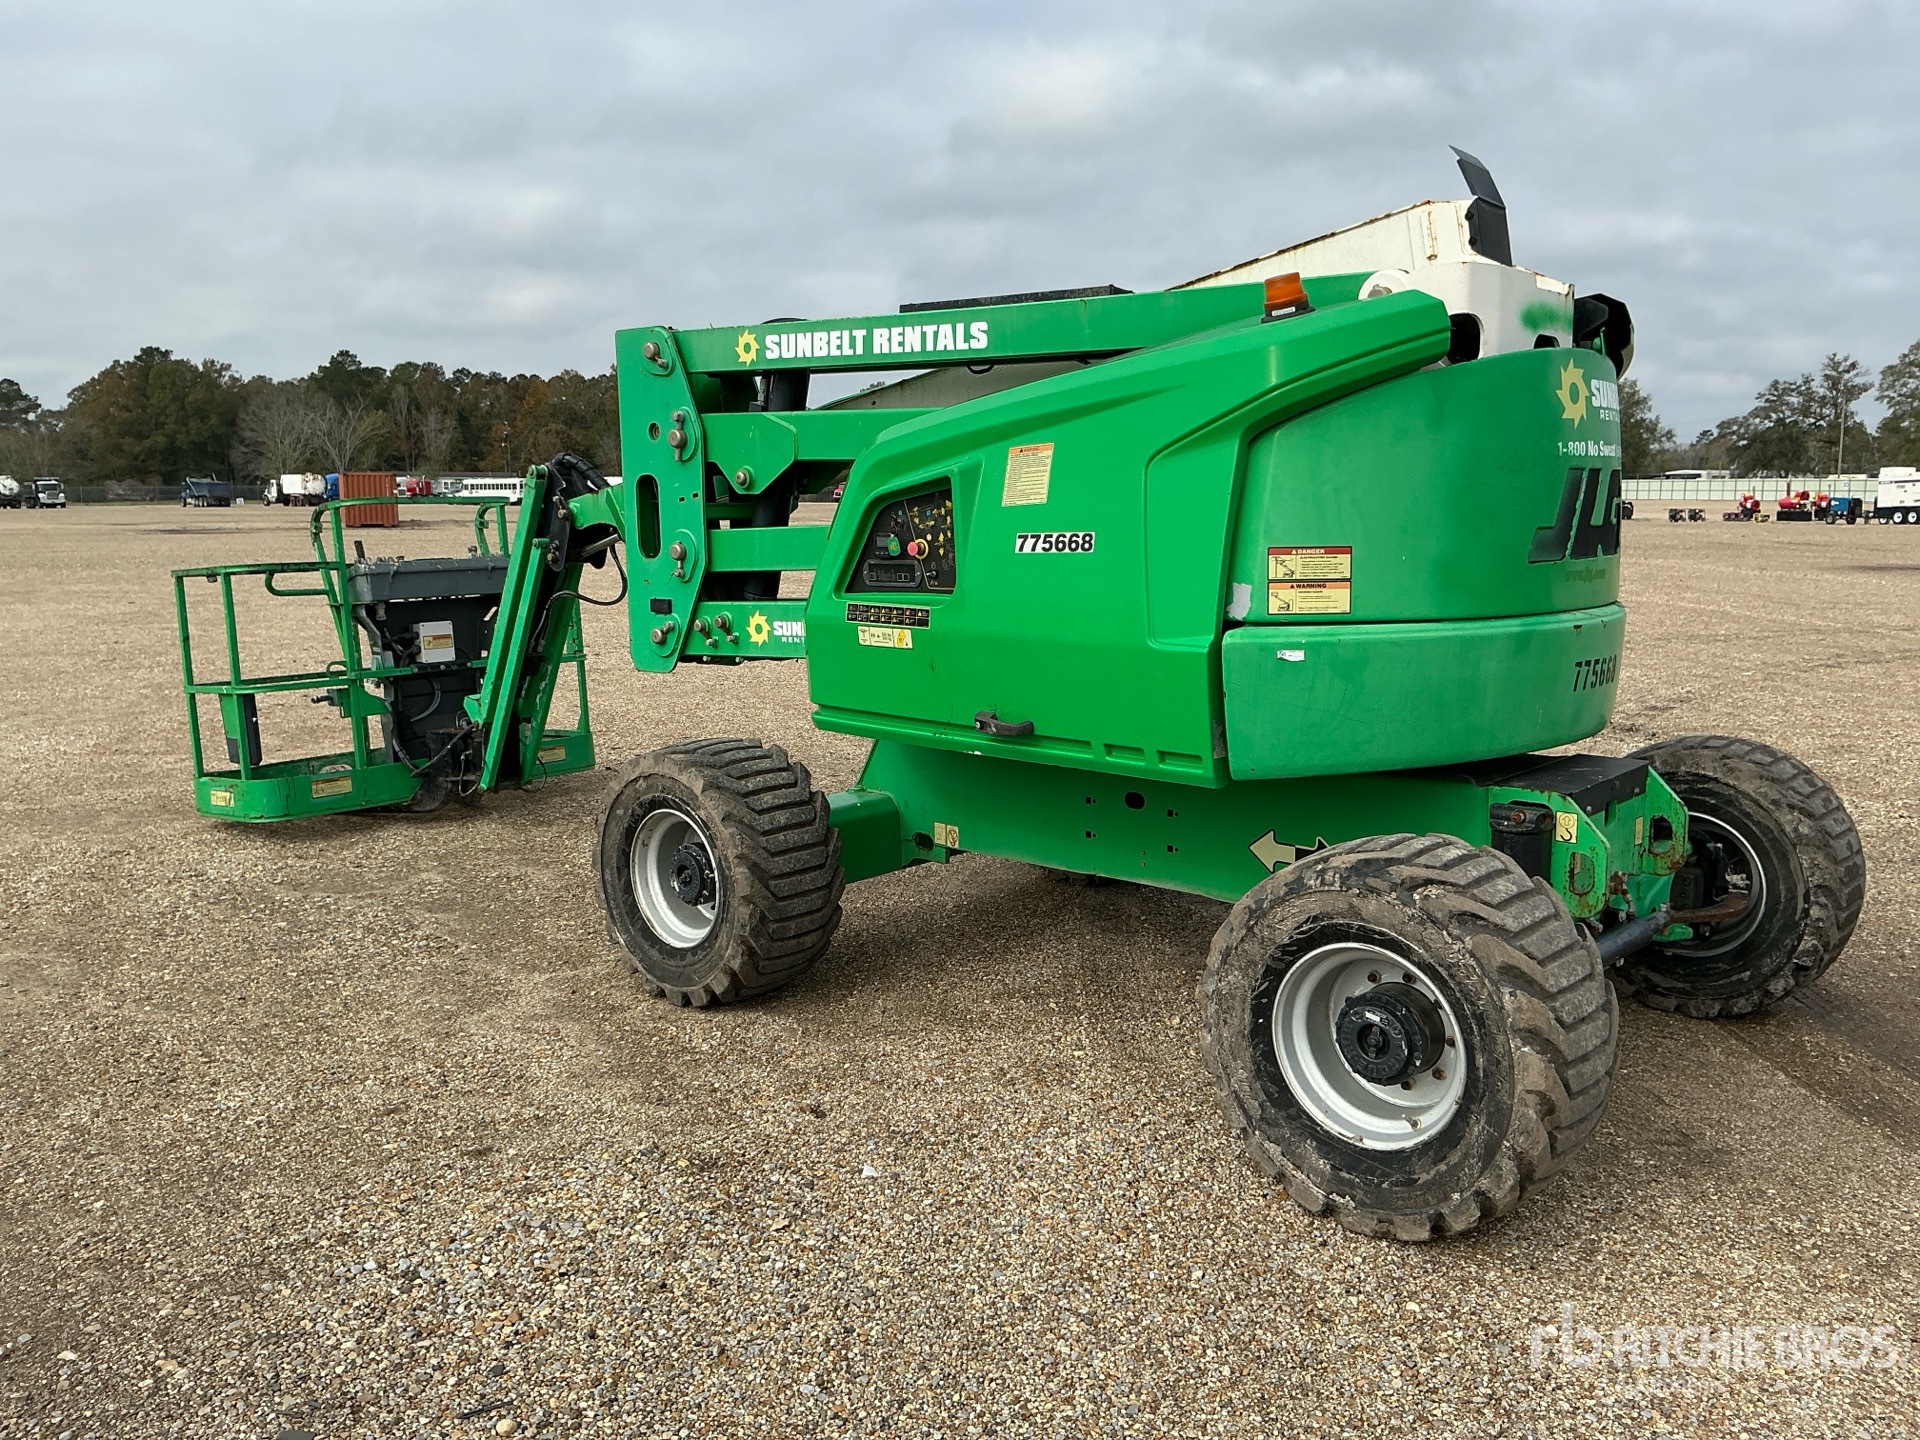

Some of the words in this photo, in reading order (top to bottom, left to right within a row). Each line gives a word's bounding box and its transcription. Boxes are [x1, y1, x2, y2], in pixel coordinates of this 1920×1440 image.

[765, 328, 867, 360] SUNBELT
[872, 321, 989, 355] RENTALS
[1557, 441, 1586, 457] 1-800
[1587, 440, 1599, 456] No
[1599, 440, 1616, 457] Sweat
[1017, 533, 1093, 553] 775668
[1573, 654, 1617, 692] 775668
